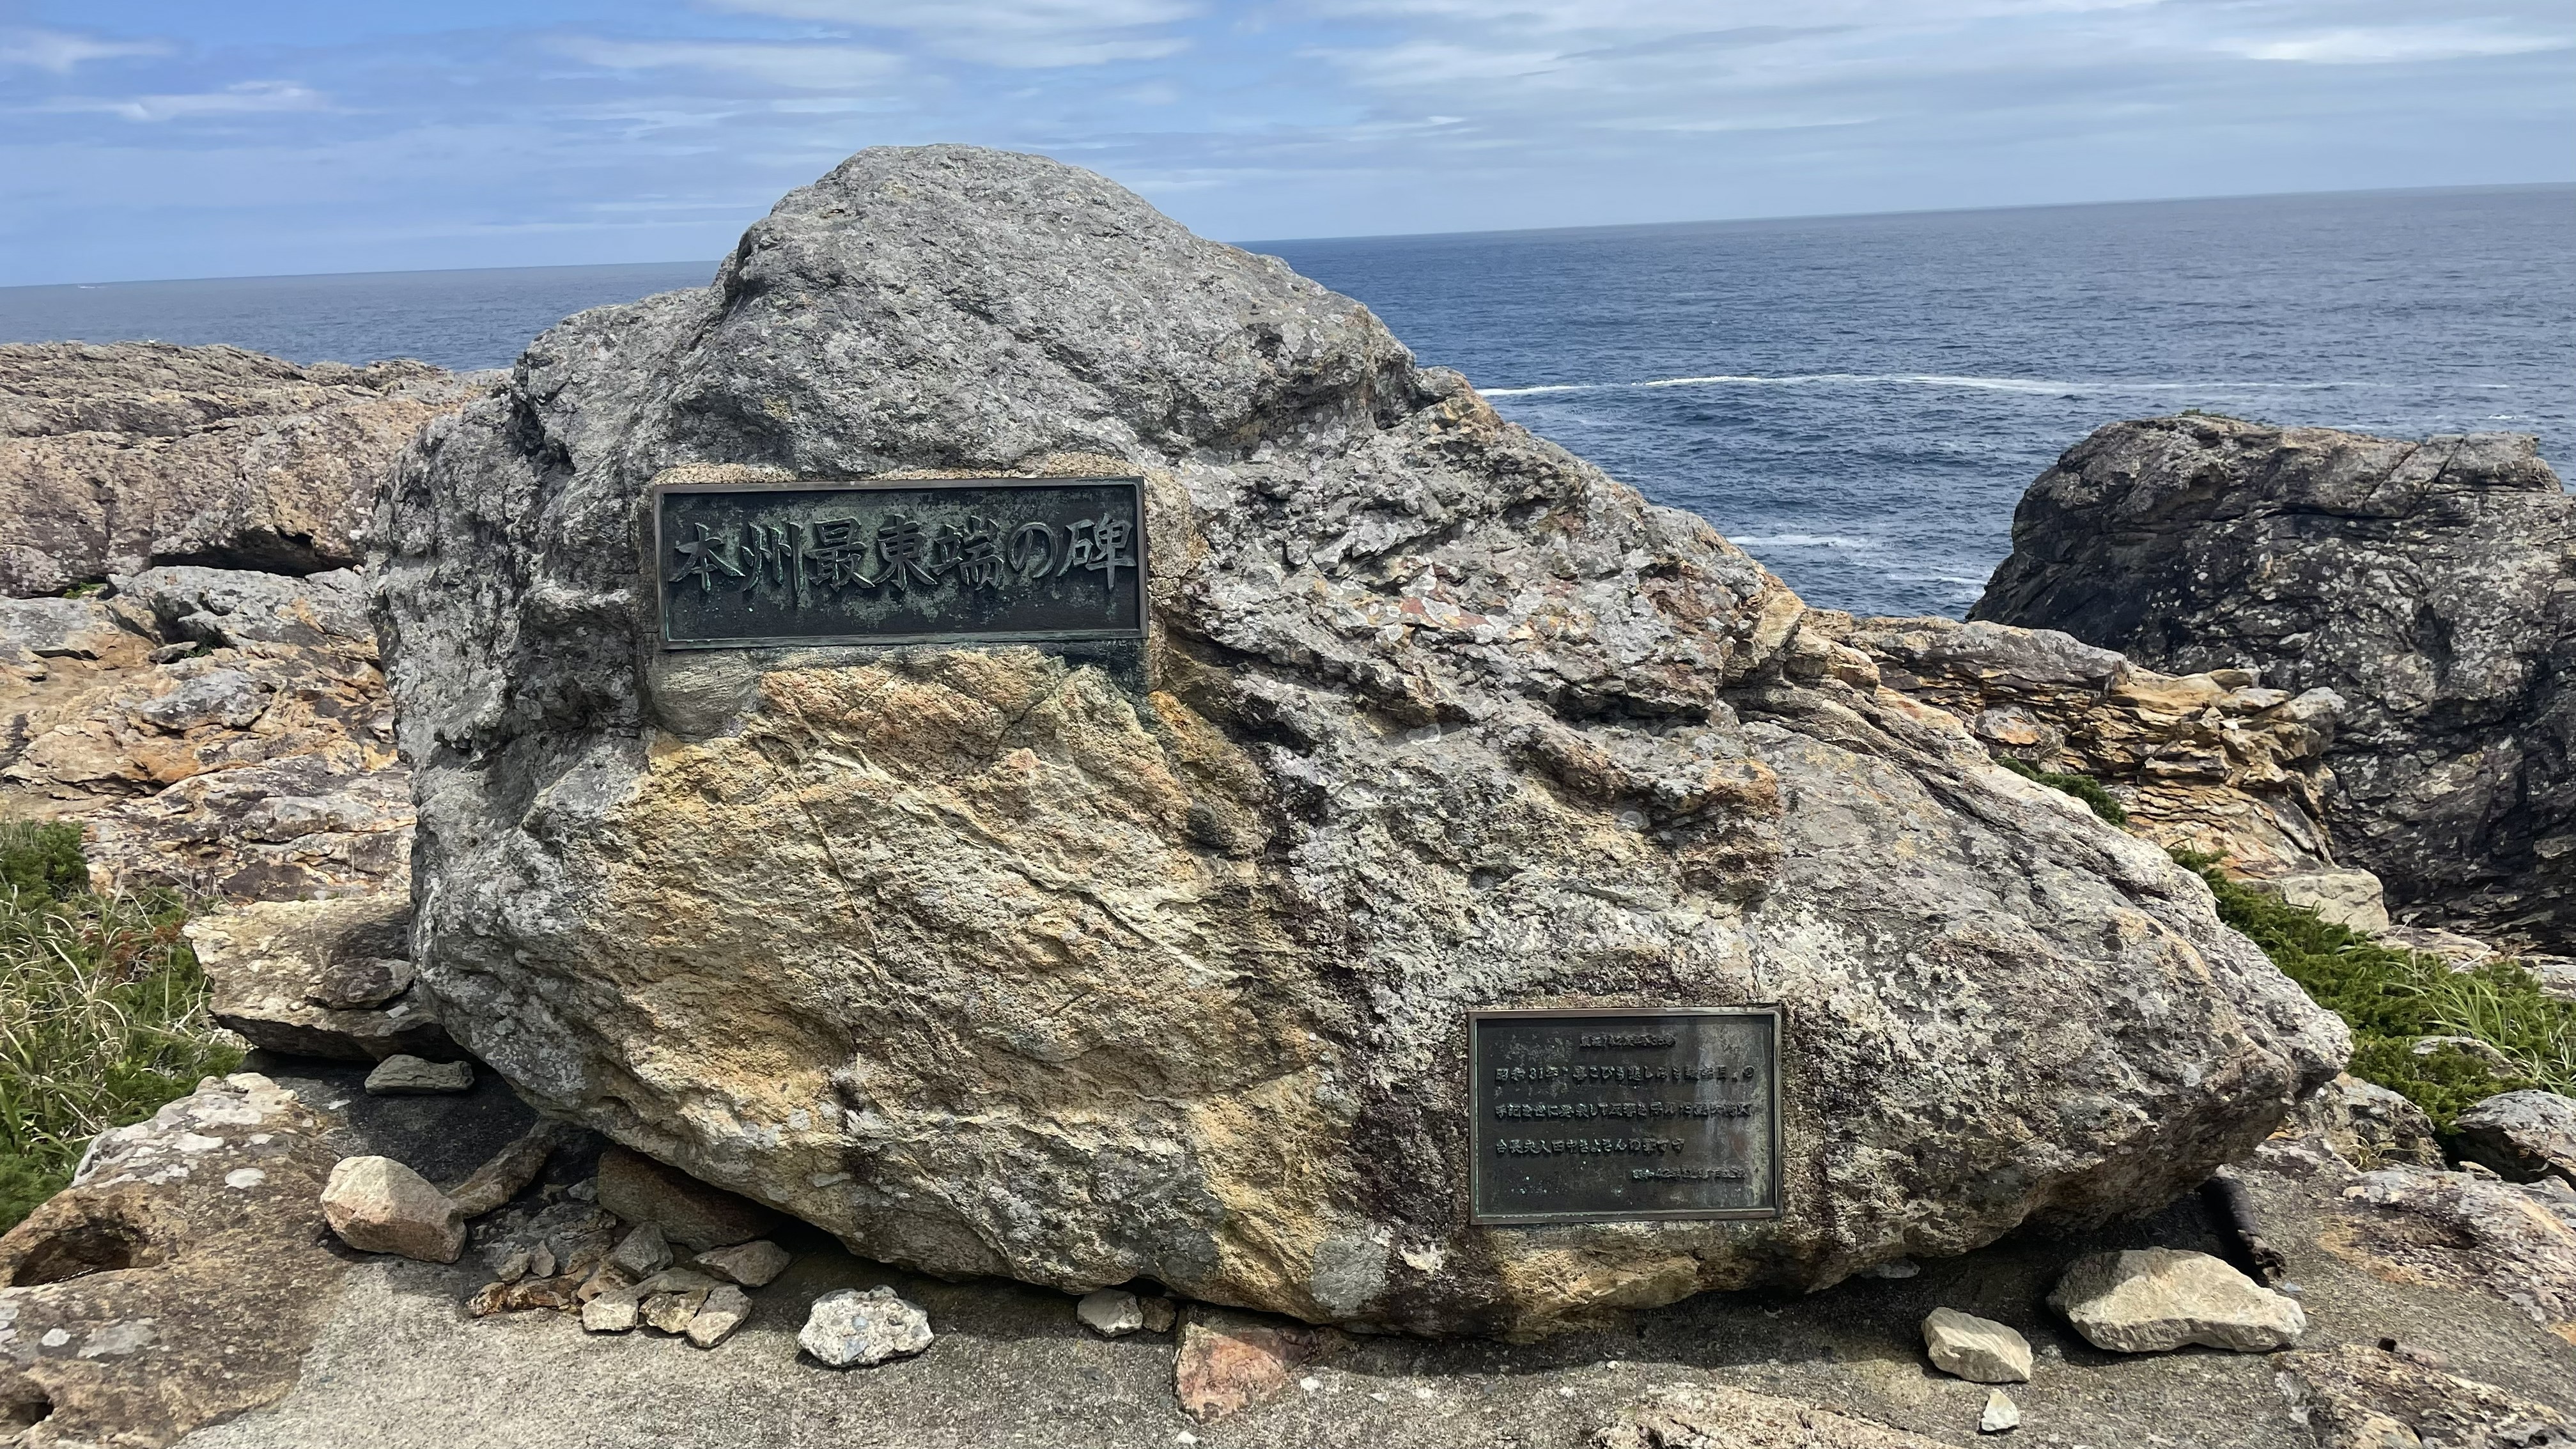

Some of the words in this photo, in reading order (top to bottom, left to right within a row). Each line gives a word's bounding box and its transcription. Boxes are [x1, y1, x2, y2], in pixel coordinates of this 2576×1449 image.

[669, 512, 1138, 596] 本州最東端の碑
